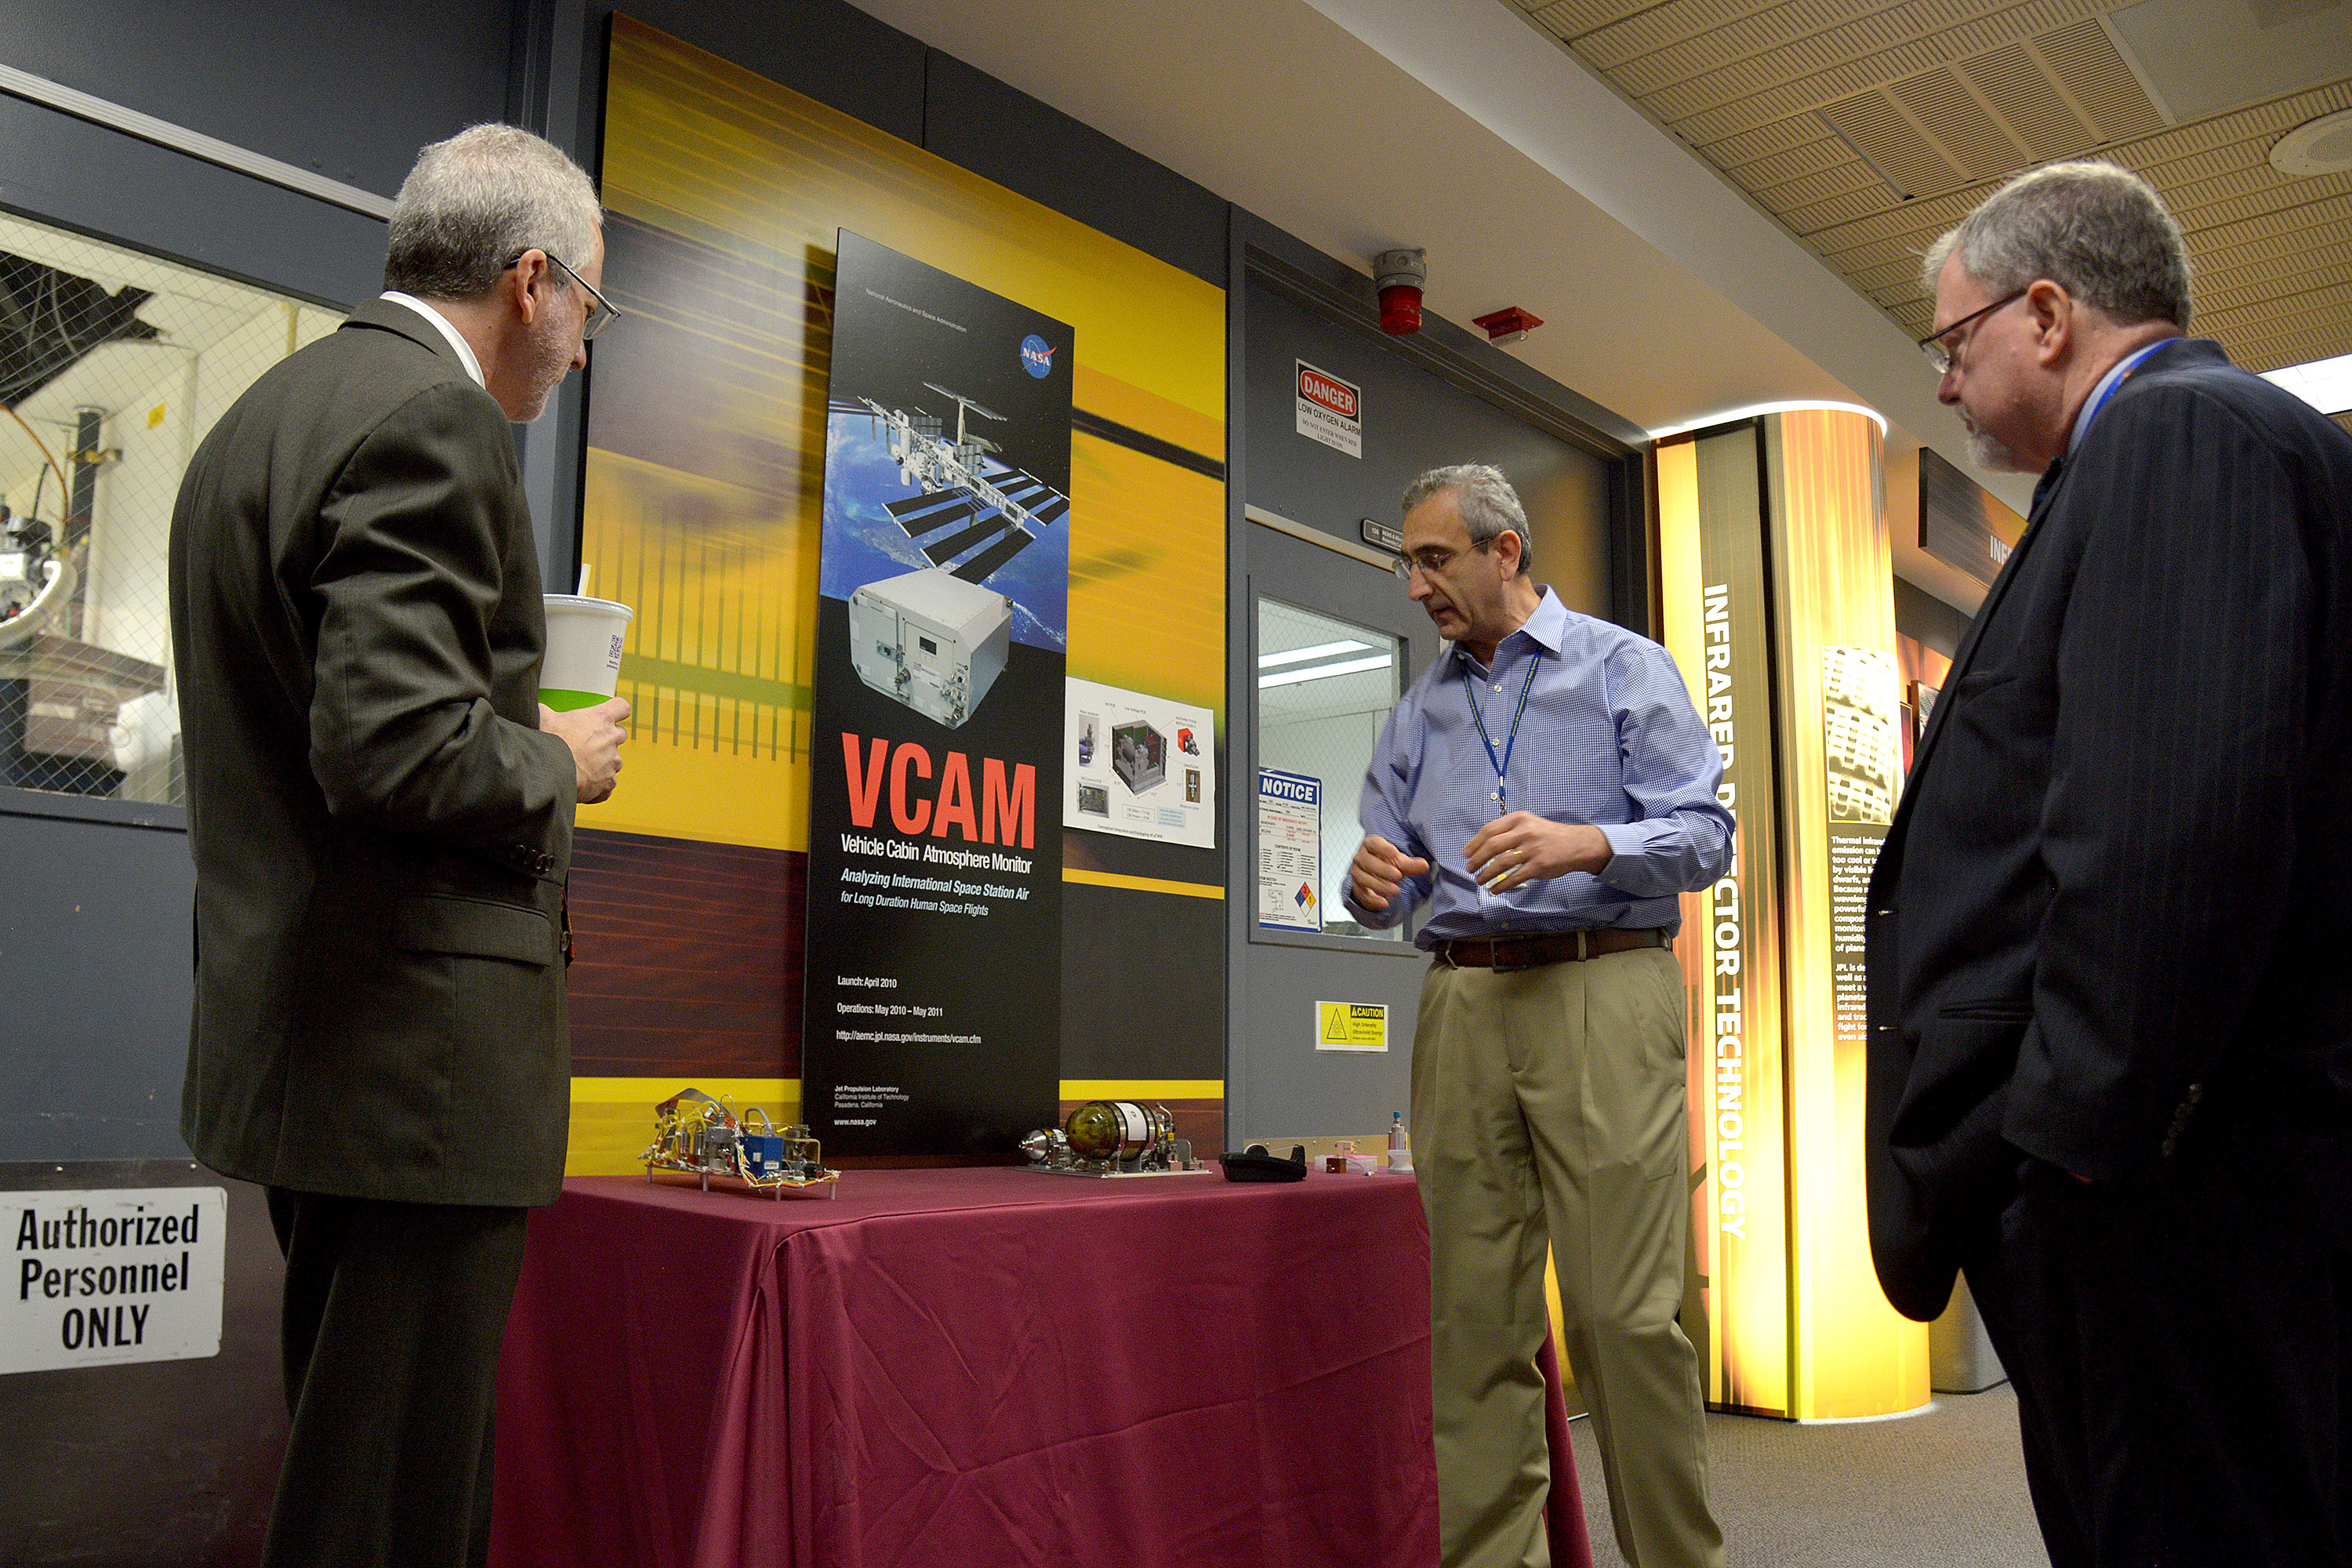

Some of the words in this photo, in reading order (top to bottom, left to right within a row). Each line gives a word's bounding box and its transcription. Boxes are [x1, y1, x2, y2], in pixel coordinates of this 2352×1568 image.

[1023, 348, 1050, 366] NASA
[1304, 375, 1353, 412] DANGER
[1298, 402, 1312, 415] LOW
[1314, 409, 1339, 427] OXYGEN
[1340, 421, 1361, 436] ALARM
[1319, 425, 1334, 437] ENTER
[1704, 584, 1735, 771] INFRARED
[842, 732, 1036, 849] VCAM
[1262, 778, 1313, 801] NOTICE
[1831, 836, 1862, 845] Thermal
[841, 833, 884, 857] Vehicle
[886, 839, 920, 860] Cabin
[923, 844, 990, 869] Atmosphere
[992, 853, 1033, 874] Monitor
[1832, 846, 1864, 855] emission
[1833, 866, 1843, 875] by
[1844, 866, 1867, 874] visible
[841, 868, 890, 888] Analyzing
[891, 873, 952, 892] International
[953, 880, 982, 897] Space
[983, 883, 1014, 899] Station
[1016, 887, 1029, 901] Air
[1833, 875, 1861, 884] dwarfs,
[1833, 885, 1863, 893] Because
[841, 891, 853, 903] for
[854, 892, 874, 907] Long
[875, 894, 909, 908] Duration
[910, 898, 938, 911] Human
[939, 901, 963, 917] Space
[964, 903, 989, 917] Flights
[1835, 944, 1844, 952] of
[838, 975, 863, 986] Launch:
[864, 977, 879, 988] April
[880, 978, 897, 988] 2010
[837, 1002, 874, 1014] Operations:
[875, 1004, 889, 1016] May
[890, 1005, 907, 1015] 2010
[913, 1007, 927, 1018] May
[928, 1007, 943, 1017] 2011
[1357, 1007, 1384, 1017] CAUTION
[1837, 1003, 1866, 1011] infrared
[1837, 1022, 1856, 1032] fight
[836, 1030, 981, 1044] http://aemc.jpl.nasa.gov/instruments/vcam.cfm
[1716, 988, 1745, 1240] TECHNOLOGY
[16, 1204, 199, 1251] Authorized
[20, 1251, 189, 1300] Personnel
[62, 1304, 150, 1350] ONLY
